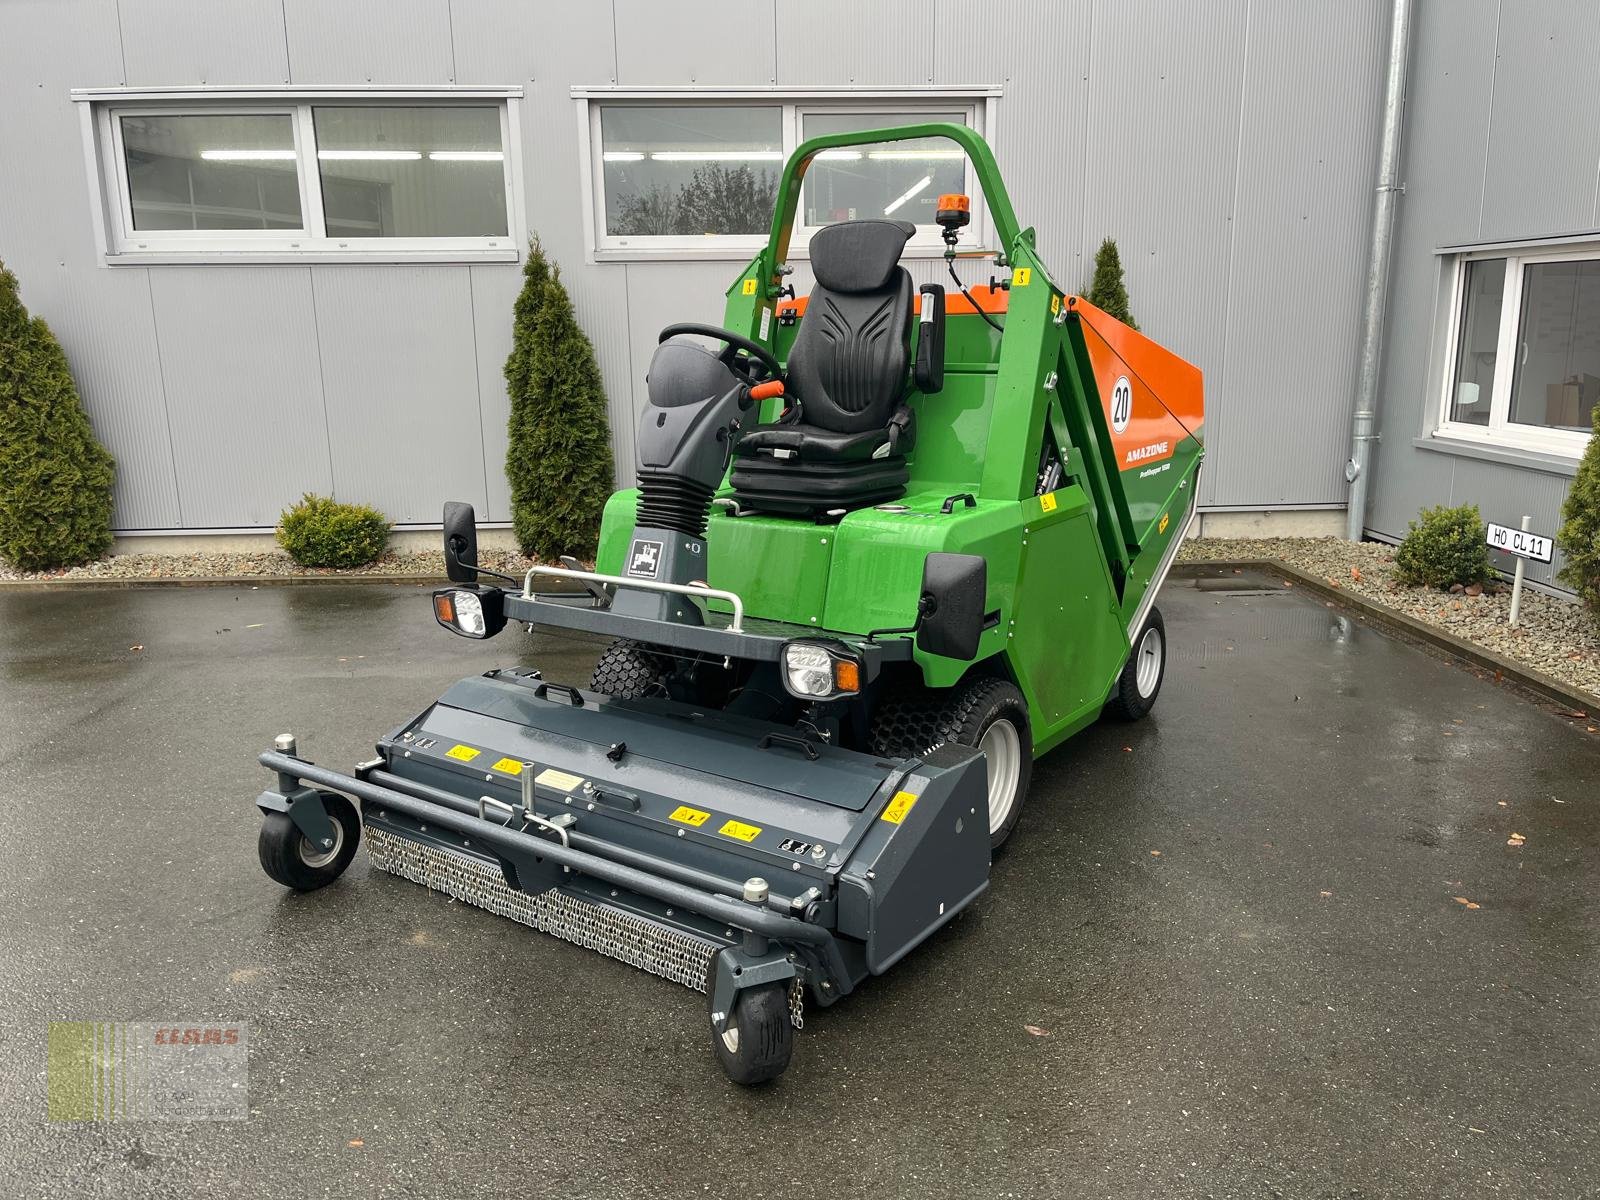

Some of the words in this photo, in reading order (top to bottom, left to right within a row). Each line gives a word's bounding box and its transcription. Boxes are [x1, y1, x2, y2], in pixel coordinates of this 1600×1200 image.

[1114, 386, 1129, 423] 20
[1126, 442, 1168, 463] AMAZONE
[1494, 528, 1507, 545] HO
[1514, 533, 1527, 551] CL
[1529, 538, 1543, 556] 11
